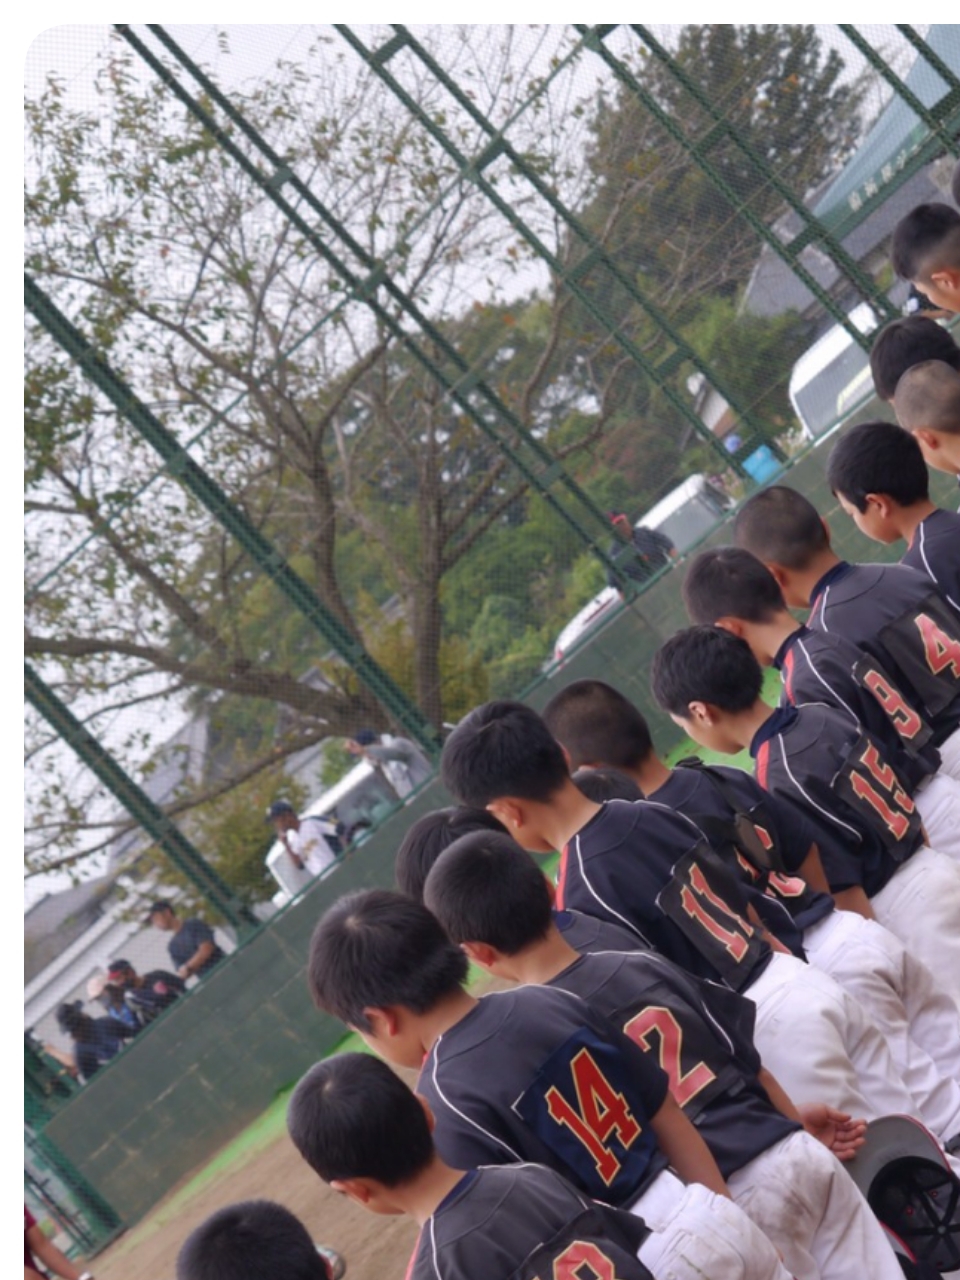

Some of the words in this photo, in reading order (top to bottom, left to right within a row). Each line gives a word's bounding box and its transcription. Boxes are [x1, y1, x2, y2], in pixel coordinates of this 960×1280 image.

[863, 669, 922, 739] 9
[851, 739, 915, 841] 15
[681, 861, 755, 963] 11
[623, 1005, 716, 1108] 2
[544, 1047, 642, 1187] 14
